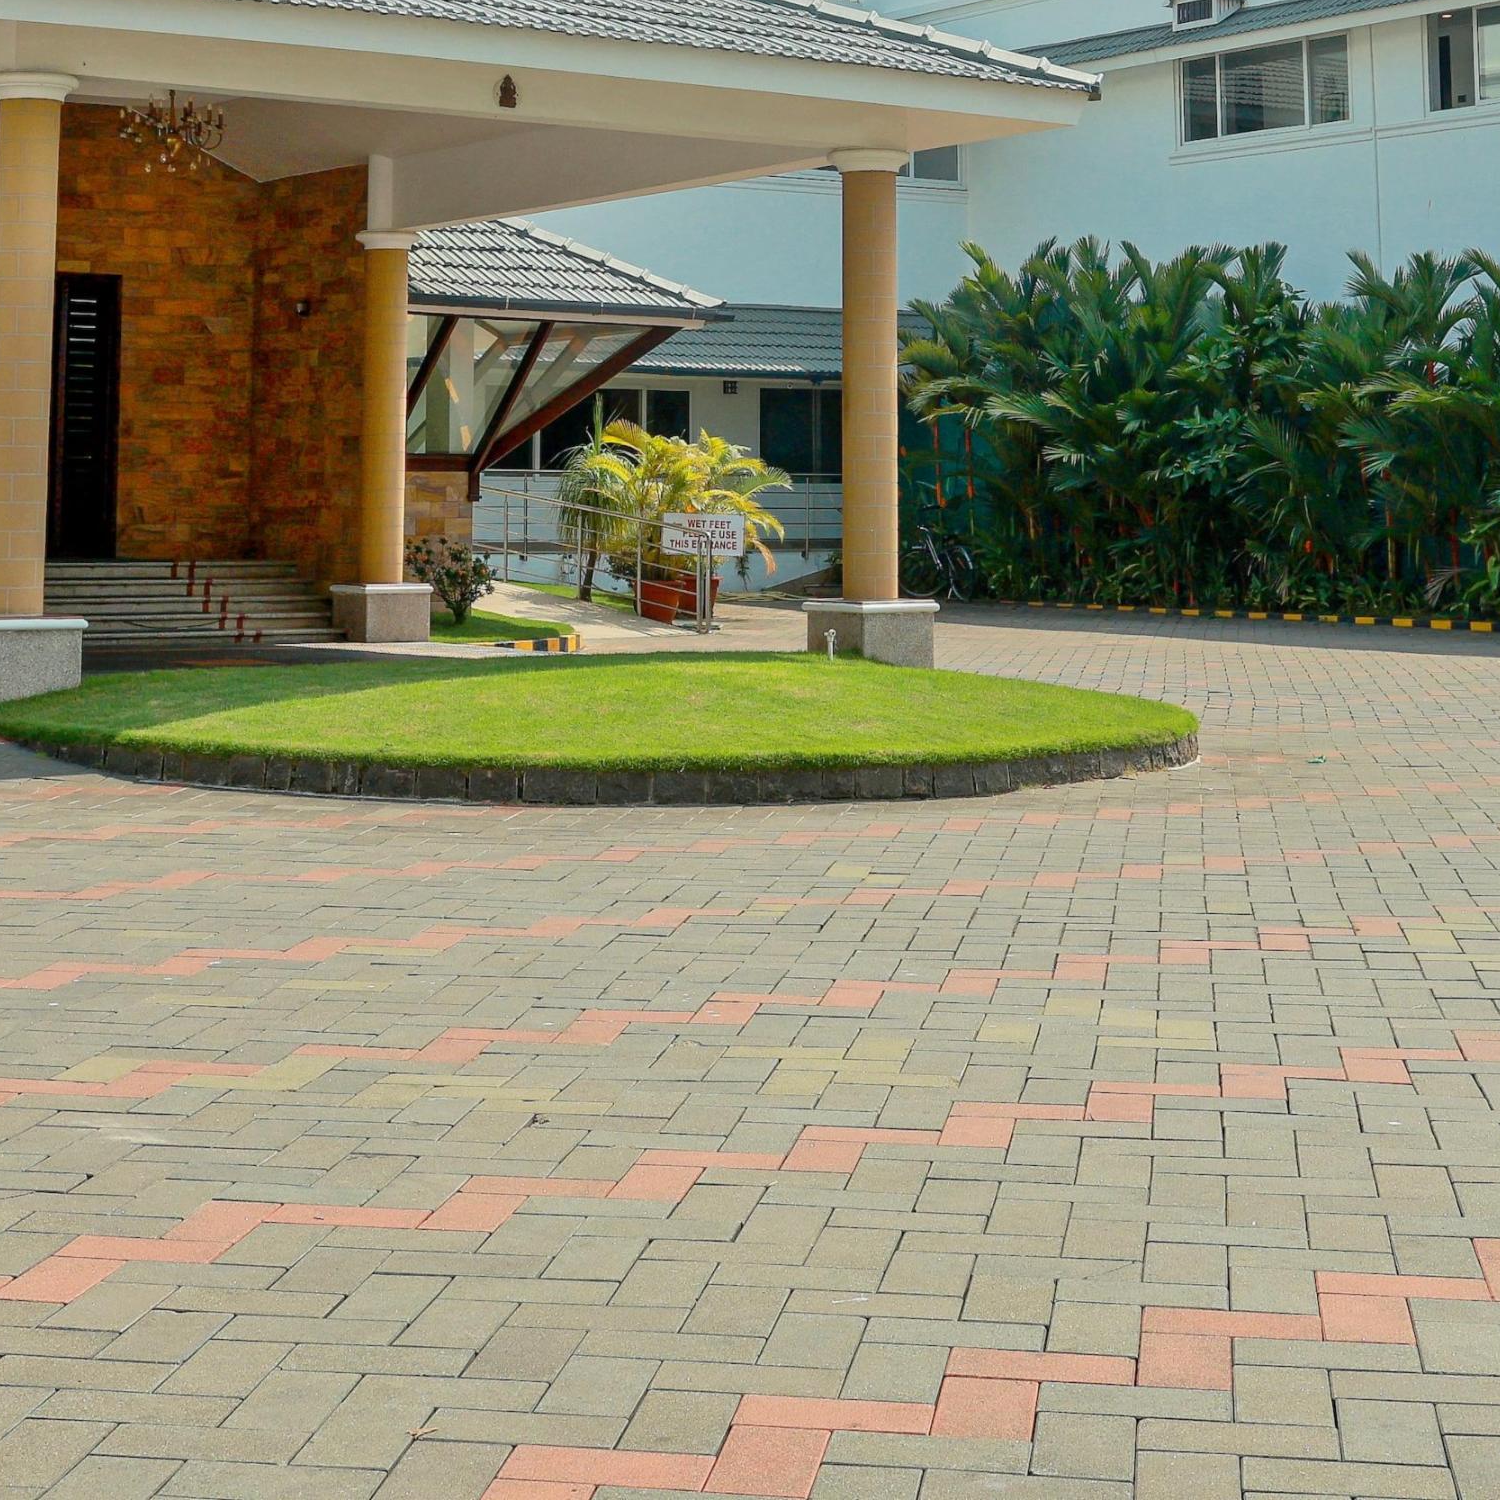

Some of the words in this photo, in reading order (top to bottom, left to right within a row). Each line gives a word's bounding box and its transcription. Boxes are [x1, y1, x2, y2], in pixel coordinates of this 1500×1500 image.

[687, 519, 706, 529] WET
[709, 520, 732, 530] FEET
[683, 529, 716, 539] PLEE
[718, 530, 737, 540] USE
[669, 539, 689, 549] THIS
